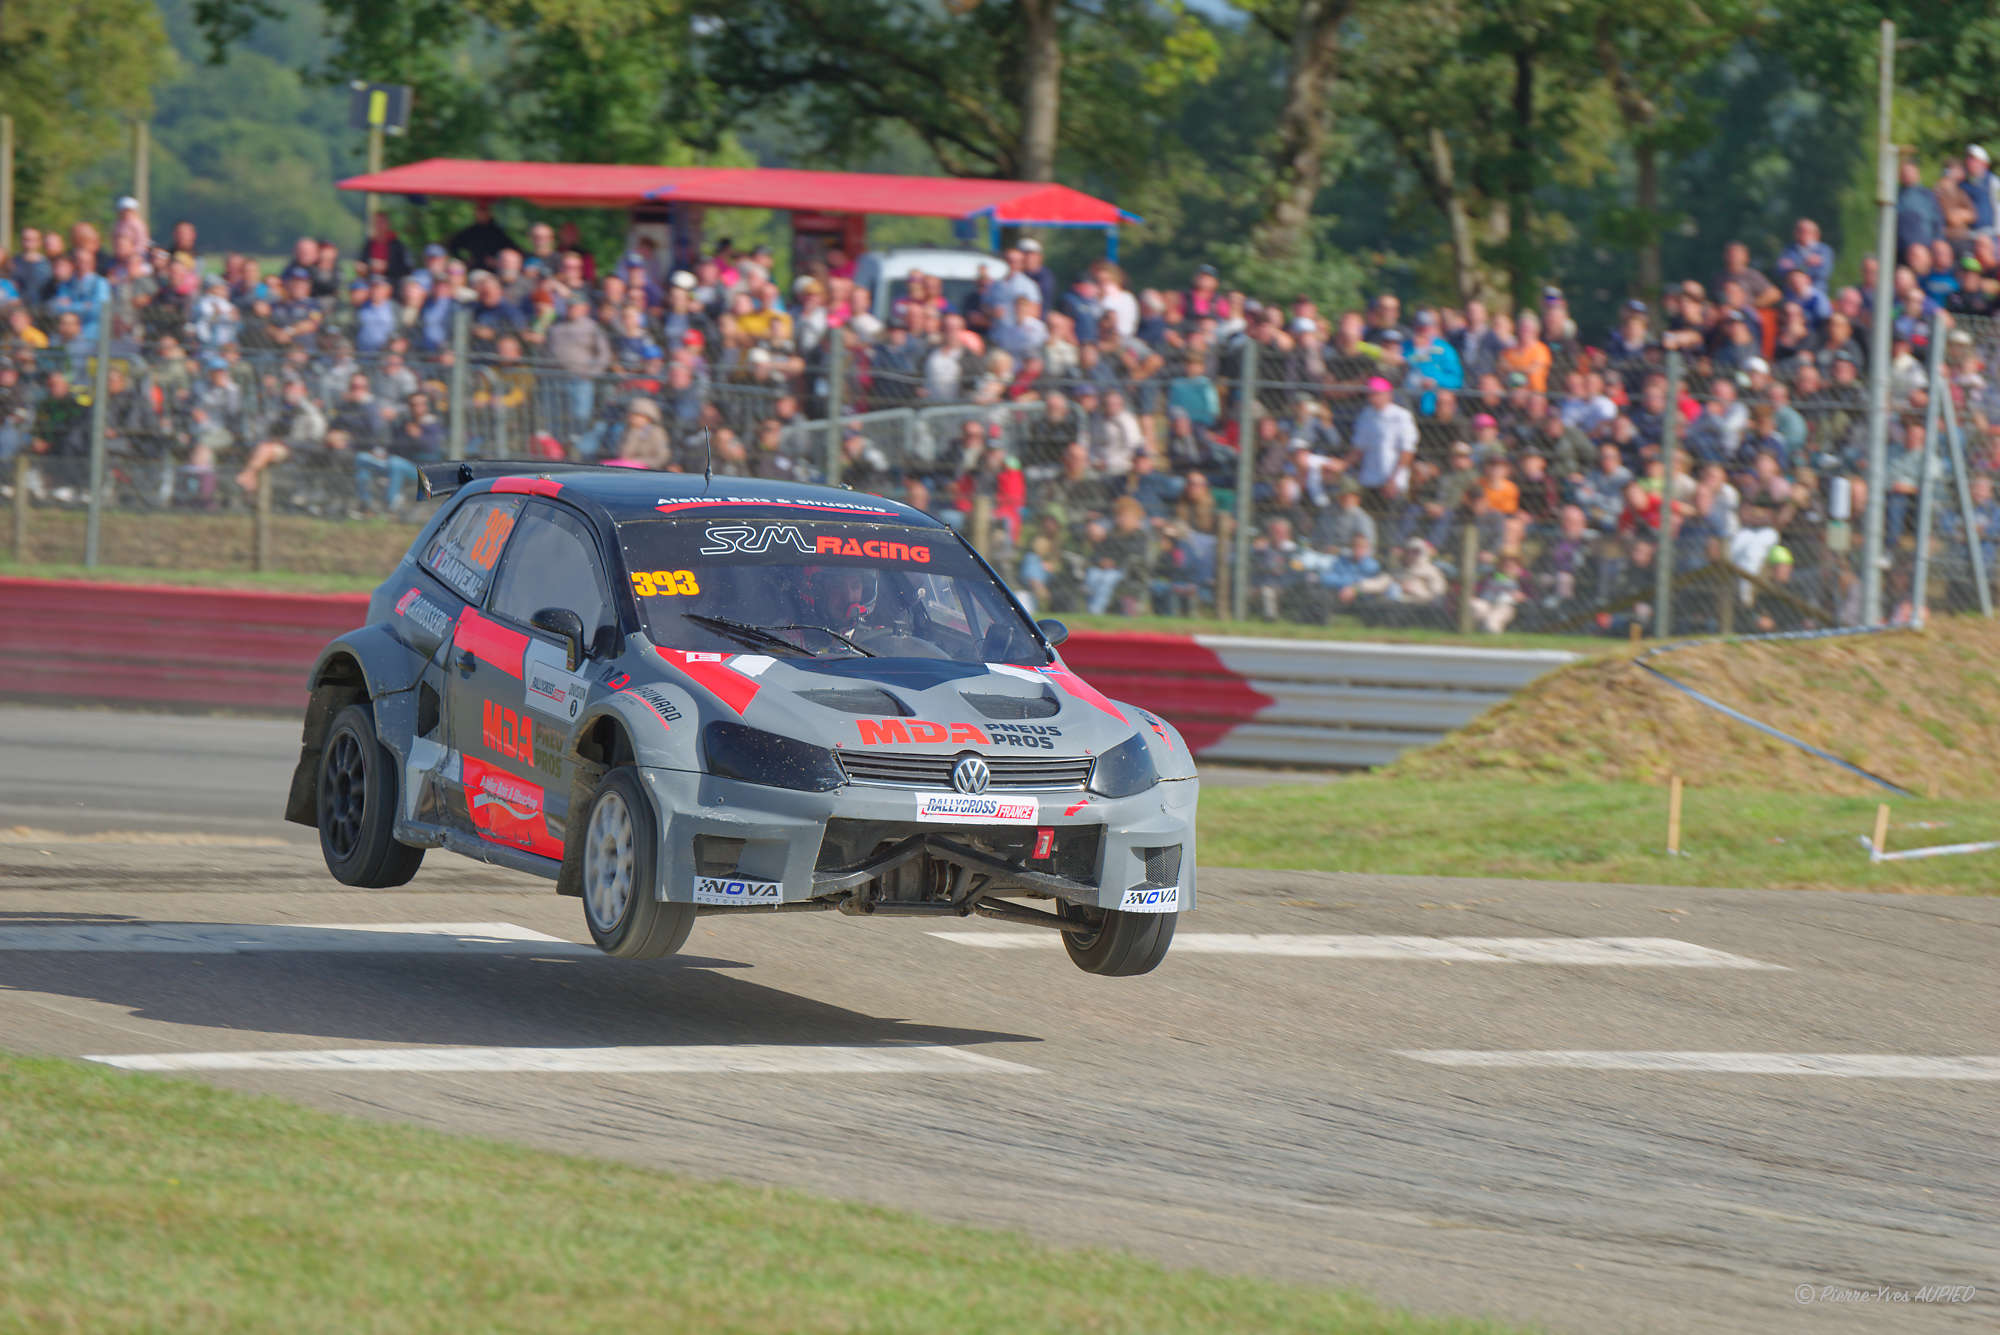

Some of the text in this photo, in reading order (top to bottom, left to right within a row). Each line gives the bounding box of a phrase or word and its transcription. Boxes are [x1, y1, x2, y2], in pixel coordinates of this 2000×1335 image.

[796, 499, 886, 513] Structure
[631, 569, 700, 597] 393
[483, 699, 535, 768] MDA
[856, 719, 991, 745] MDA
[984, 723, 1063, 737] PNEUS
[991, 733, 1055, 750] PROS
[927, 797, 1033, 819] RALLYCROSS FRANCE
[699, 879, 778, 897] NOVA
[1126, 889, 1176, 904] NOVA
